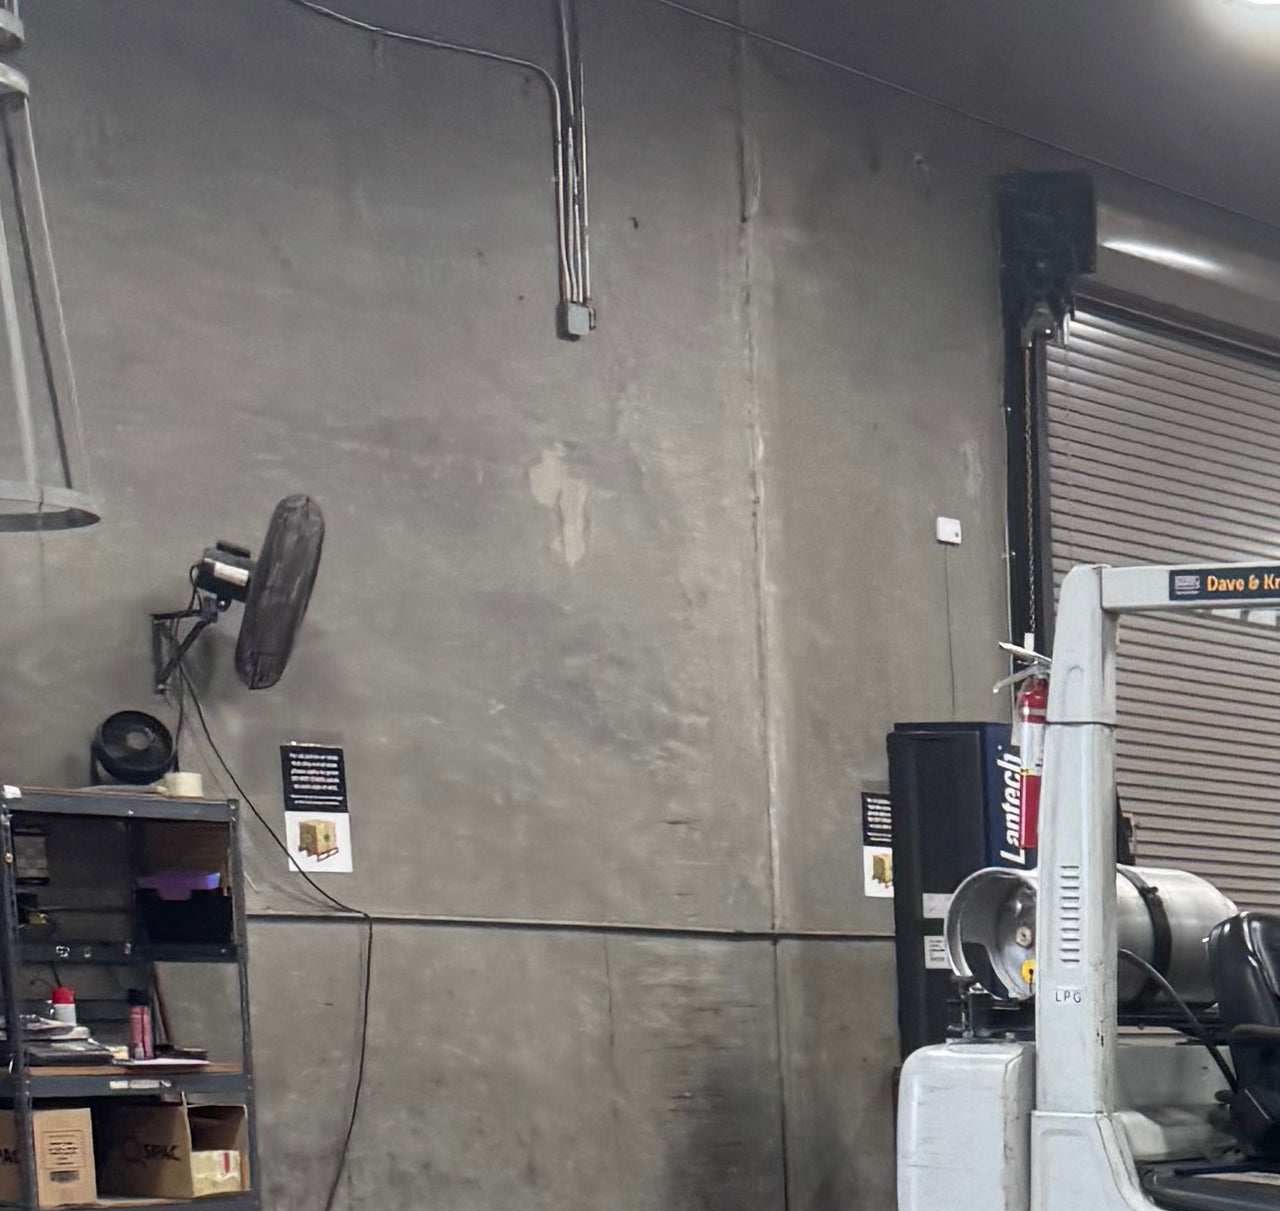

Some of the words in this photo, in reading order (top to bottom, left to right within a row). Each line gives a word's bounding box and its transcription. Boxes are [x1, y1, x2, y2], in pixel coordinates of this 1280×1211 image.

[1206, 575, 1245, 592] Dave
[1248, 574, 1260, 591] &
[997, 752, 1026, 865] Lantech
[1055, 990, 1082, 1003] LPG
